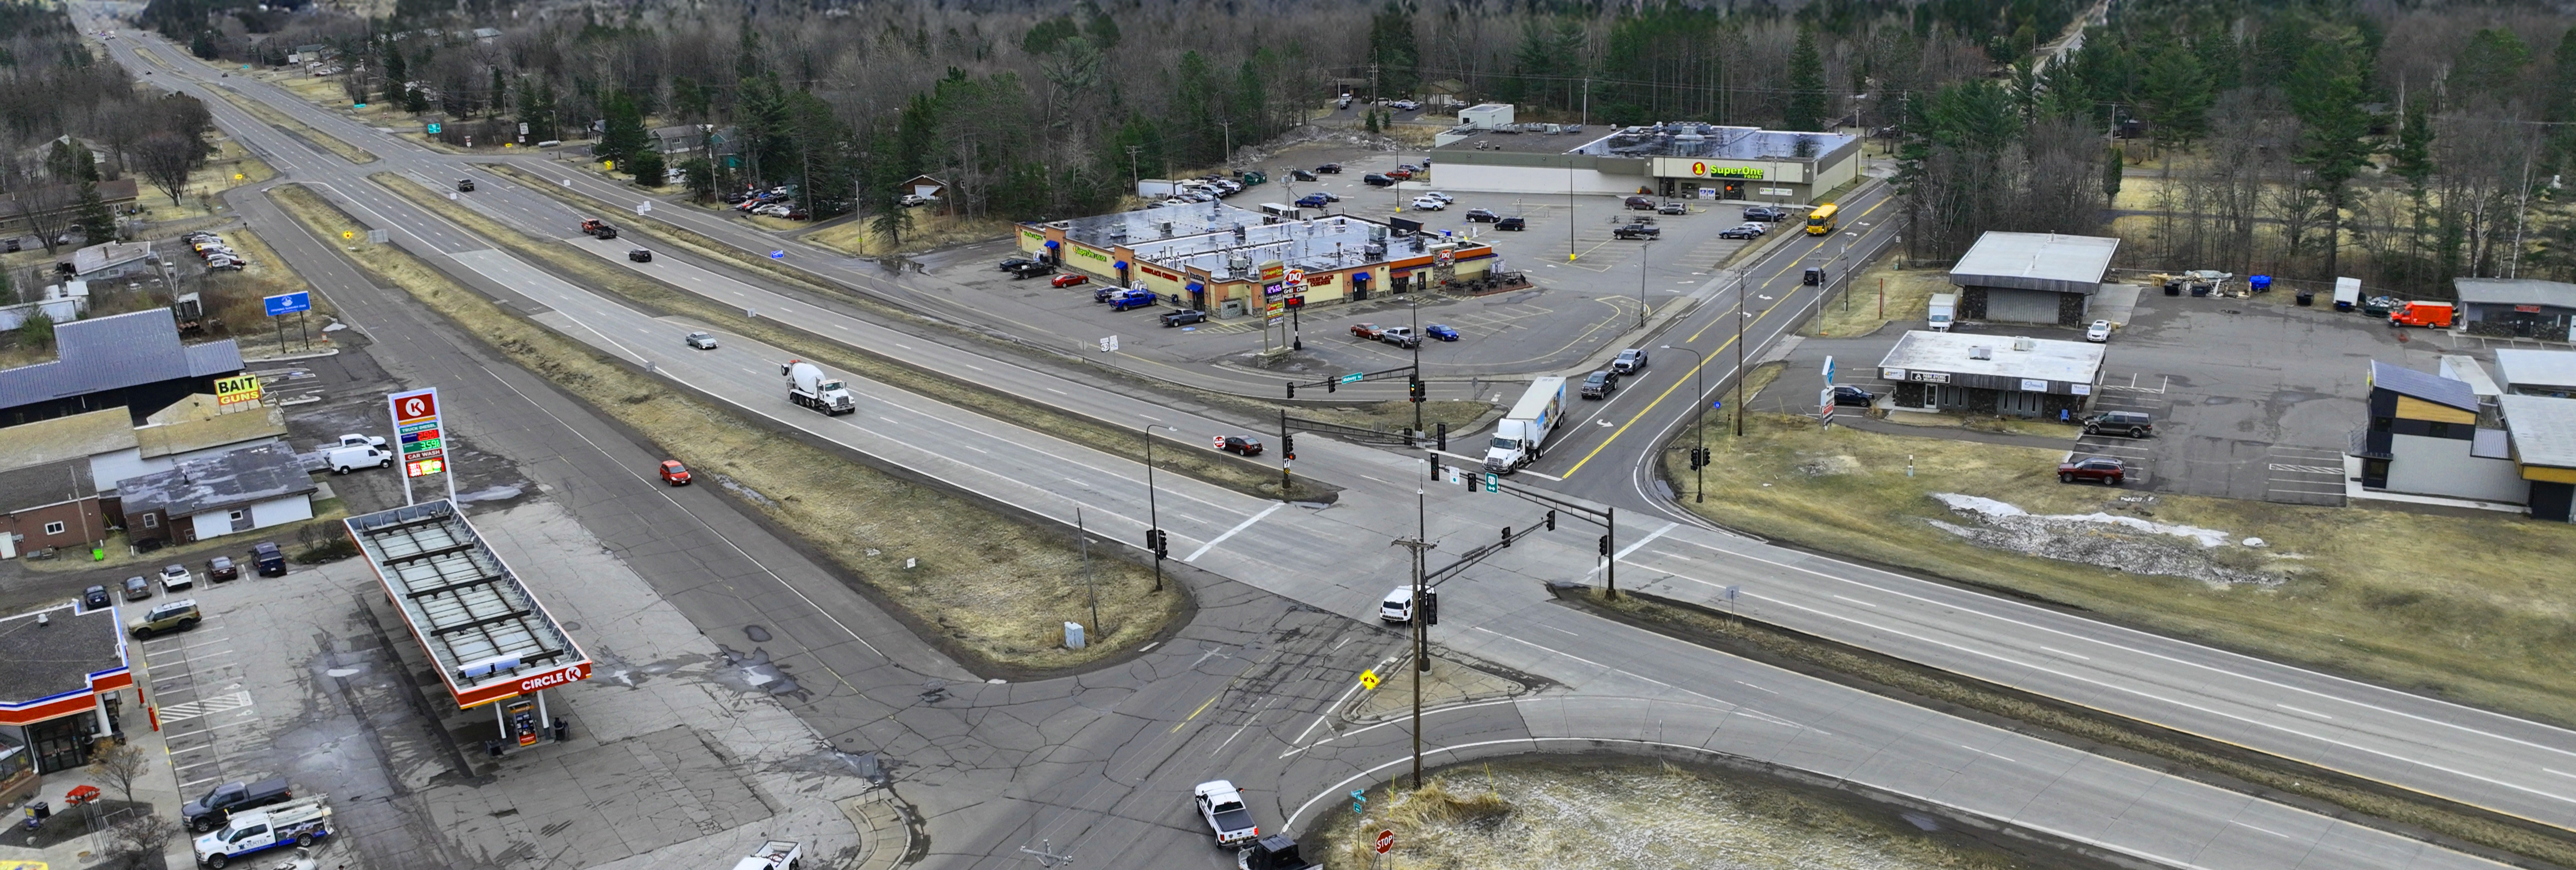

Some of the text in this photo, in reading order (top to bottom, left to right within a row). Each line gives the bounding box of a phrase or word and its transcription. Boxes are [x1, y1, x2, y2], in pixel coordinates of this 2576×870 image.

[1710, 165, 1763, 176] SuperOne
[1076, 246, 1094, 258] SuperOne
[1288, 272, 1302, 282] DQ
[218, 377, 254, 394] BAIT
[221, 392, 259, 404] GUNS
[408, 400, 425, 414] K
[522, 668, 581, 690] CIRCLE K
[1377, 834, 1392, 849] STOP
